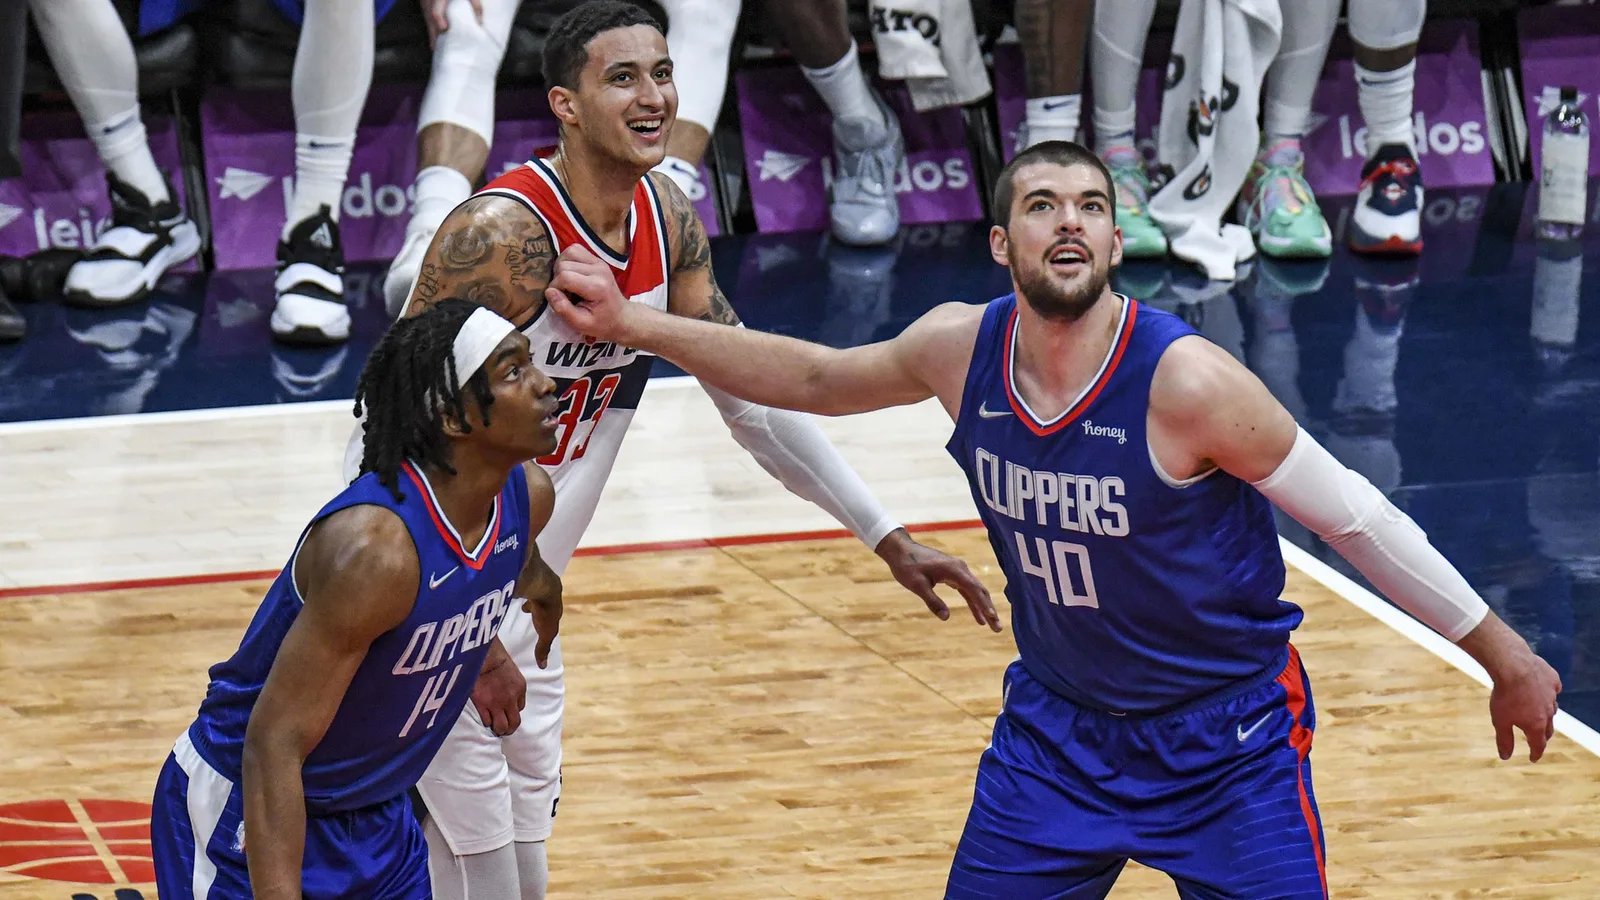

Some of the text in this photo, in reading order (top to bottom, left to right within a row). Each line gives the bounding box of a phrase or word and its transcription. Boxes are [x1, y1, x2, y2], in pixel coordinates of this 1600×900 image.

[1081, 420, 1127, 444] honey
[975, 447, 1130, 537] CLIPPERS
[494, 533, 519, 555] honey
[1014, 531, 1099, 609] 40
[392, 579, 516, 676] CLIPPERS
[398, 663, 463, 738] 14
